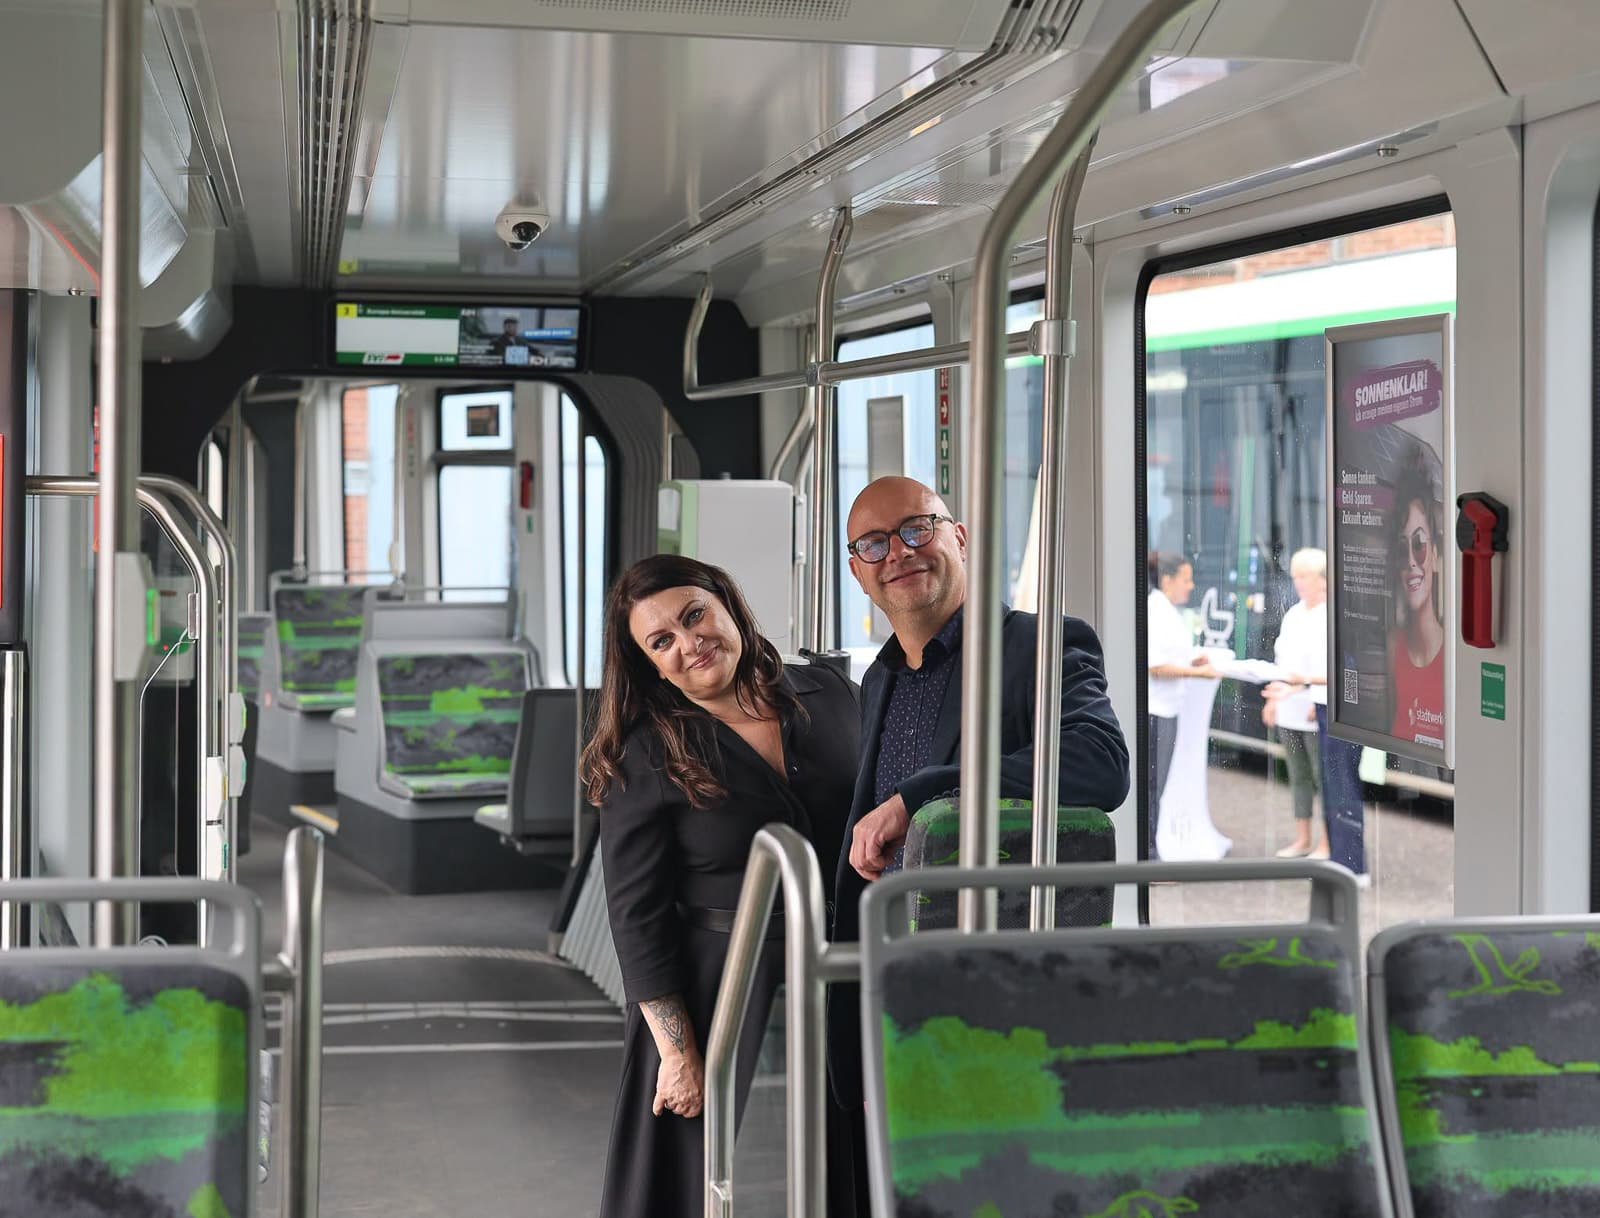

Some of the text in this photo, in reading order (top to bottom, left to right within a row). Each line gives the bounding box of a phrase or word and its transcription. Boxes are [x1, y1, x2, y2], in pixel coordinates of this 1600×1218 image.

[1355, 369, 1428, 408] SONNENKLAR!
[1341, 470, 1357, 484] Sonne
[1342, 490, 1353, 505] Geld
[1342, 510, 1361, 525] Zukunft
